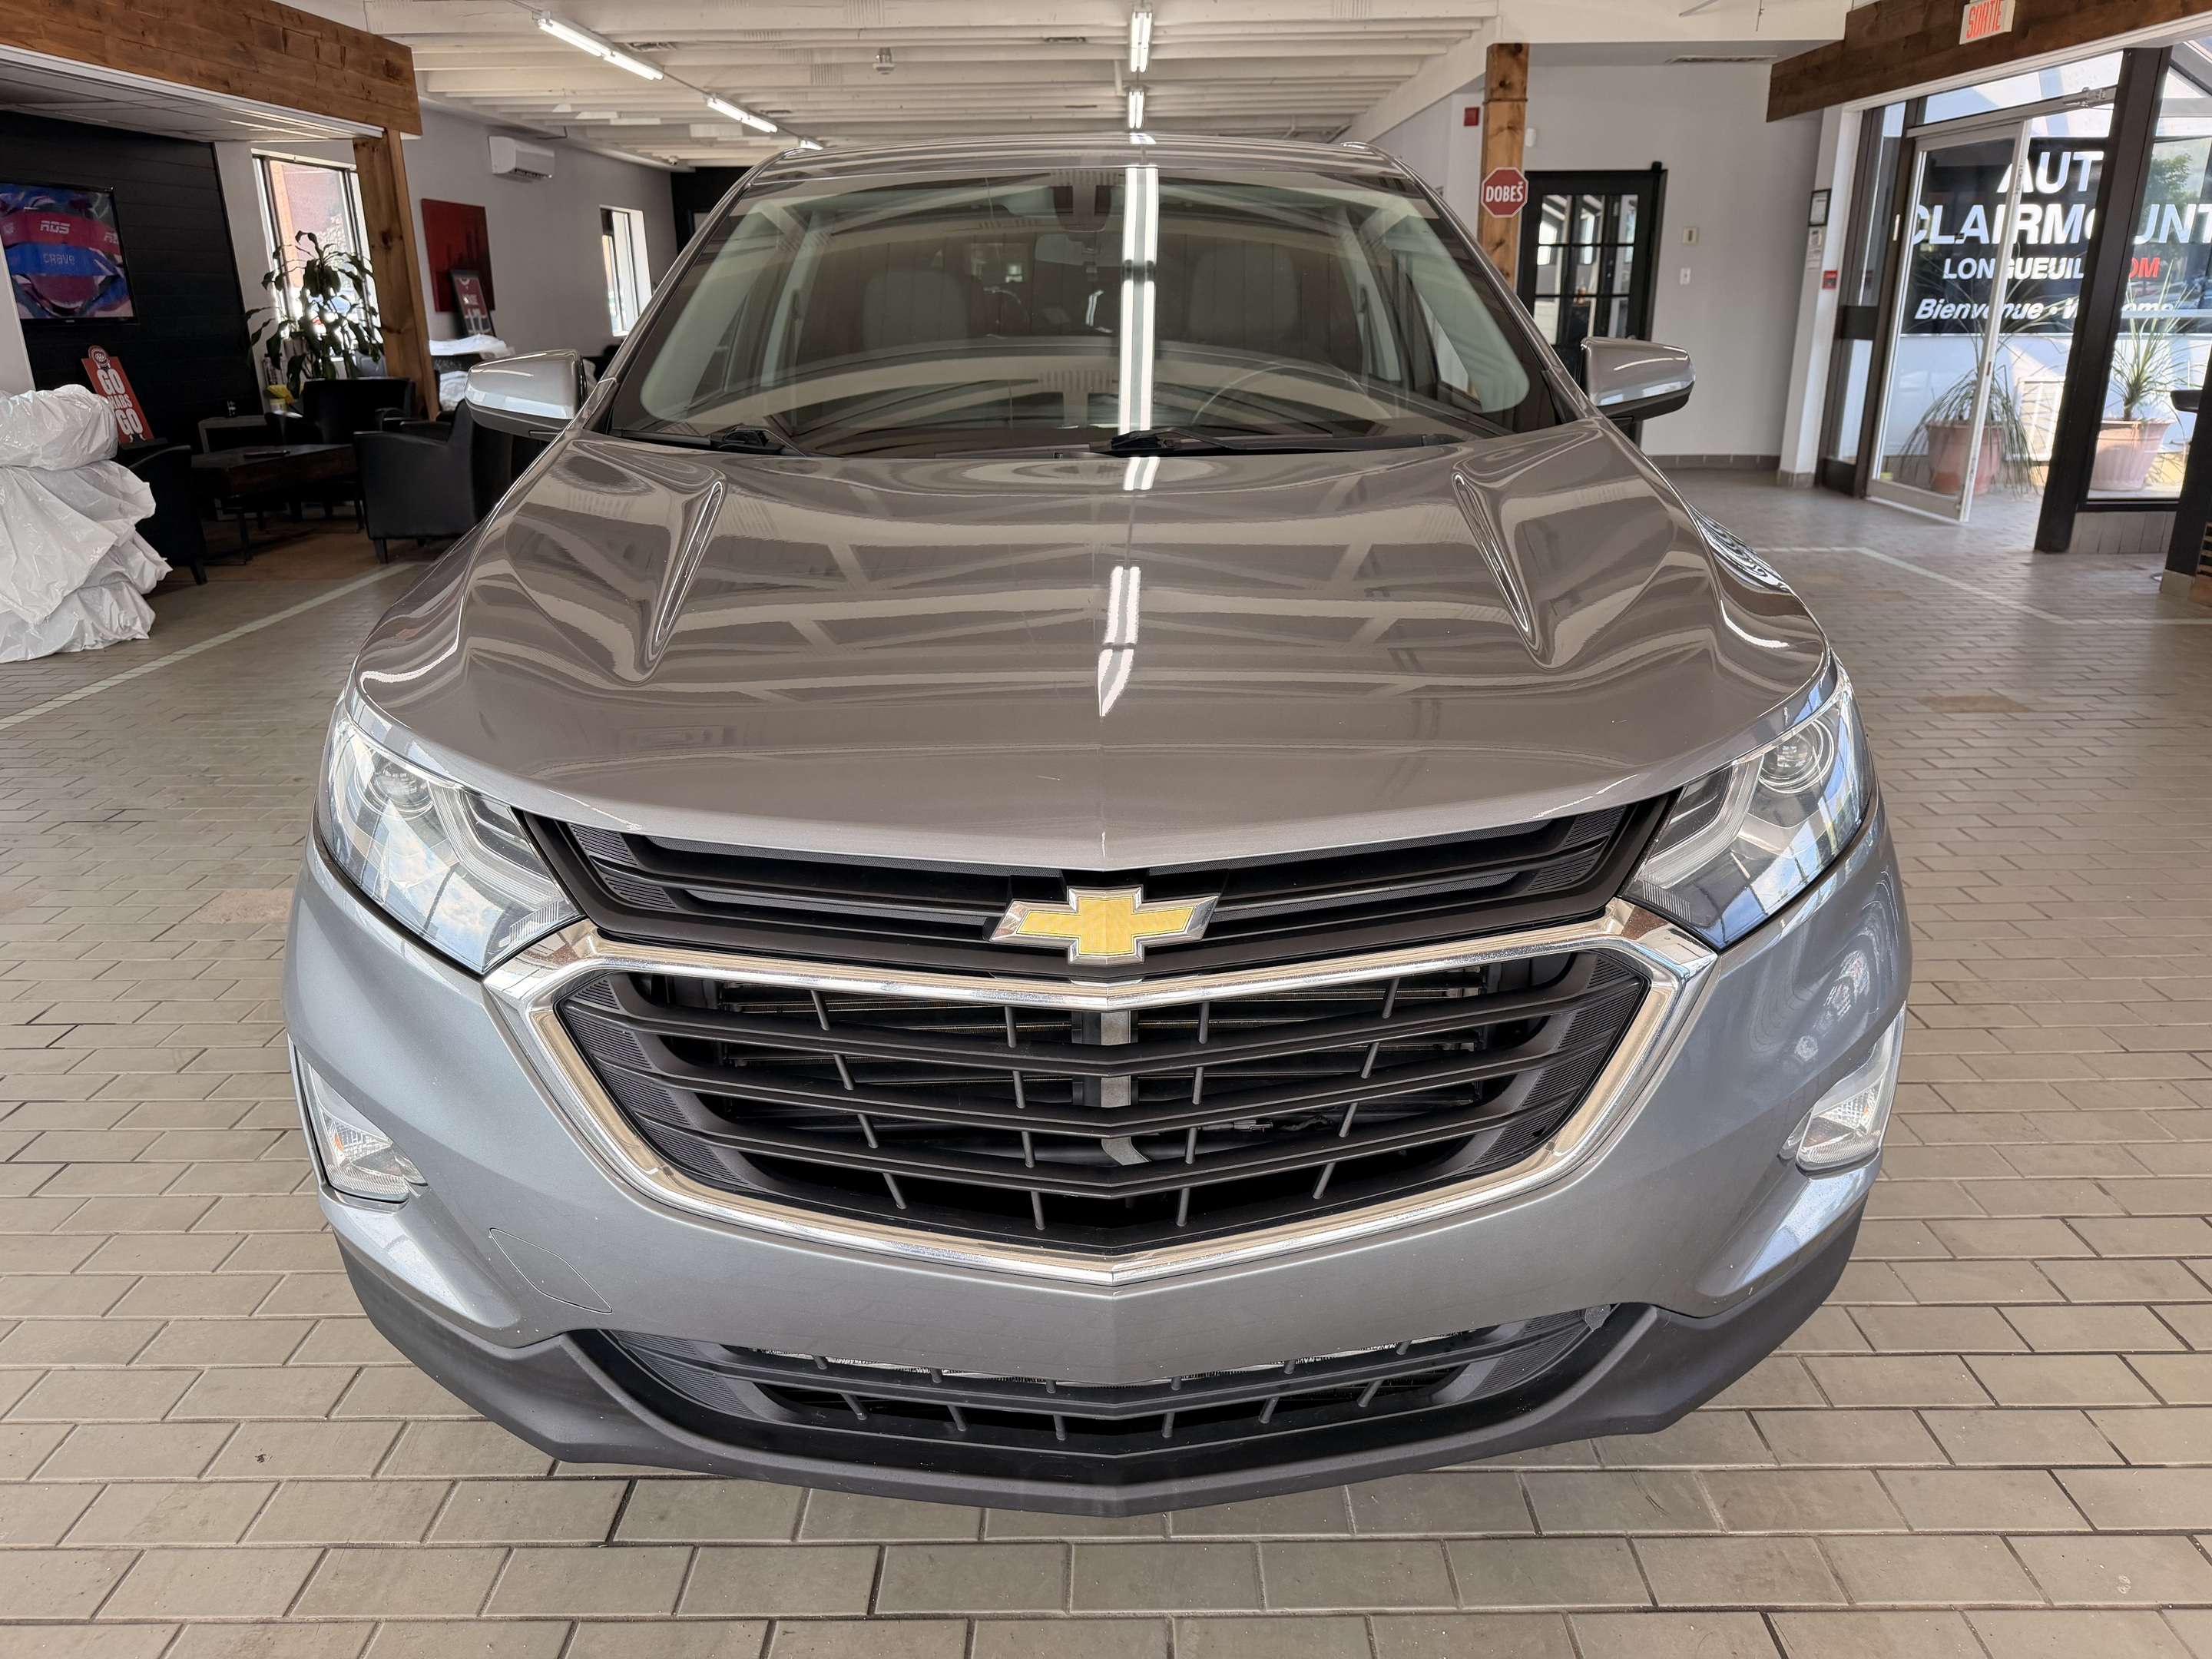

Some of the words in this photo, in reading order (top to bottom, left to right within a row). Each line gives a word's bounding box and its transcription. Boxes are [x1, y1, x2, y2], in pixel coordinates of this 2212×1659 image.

[1966, 0, 2002, 39] SORTIE
[1995, 151, 2104, 194] AUT
[1912, 204, 2212, 245] CLAIRMUNT
[97, 369, 125, 395] GO
[108, 394, 133, 409] HABS
[114, 408, 144, 435] GO
